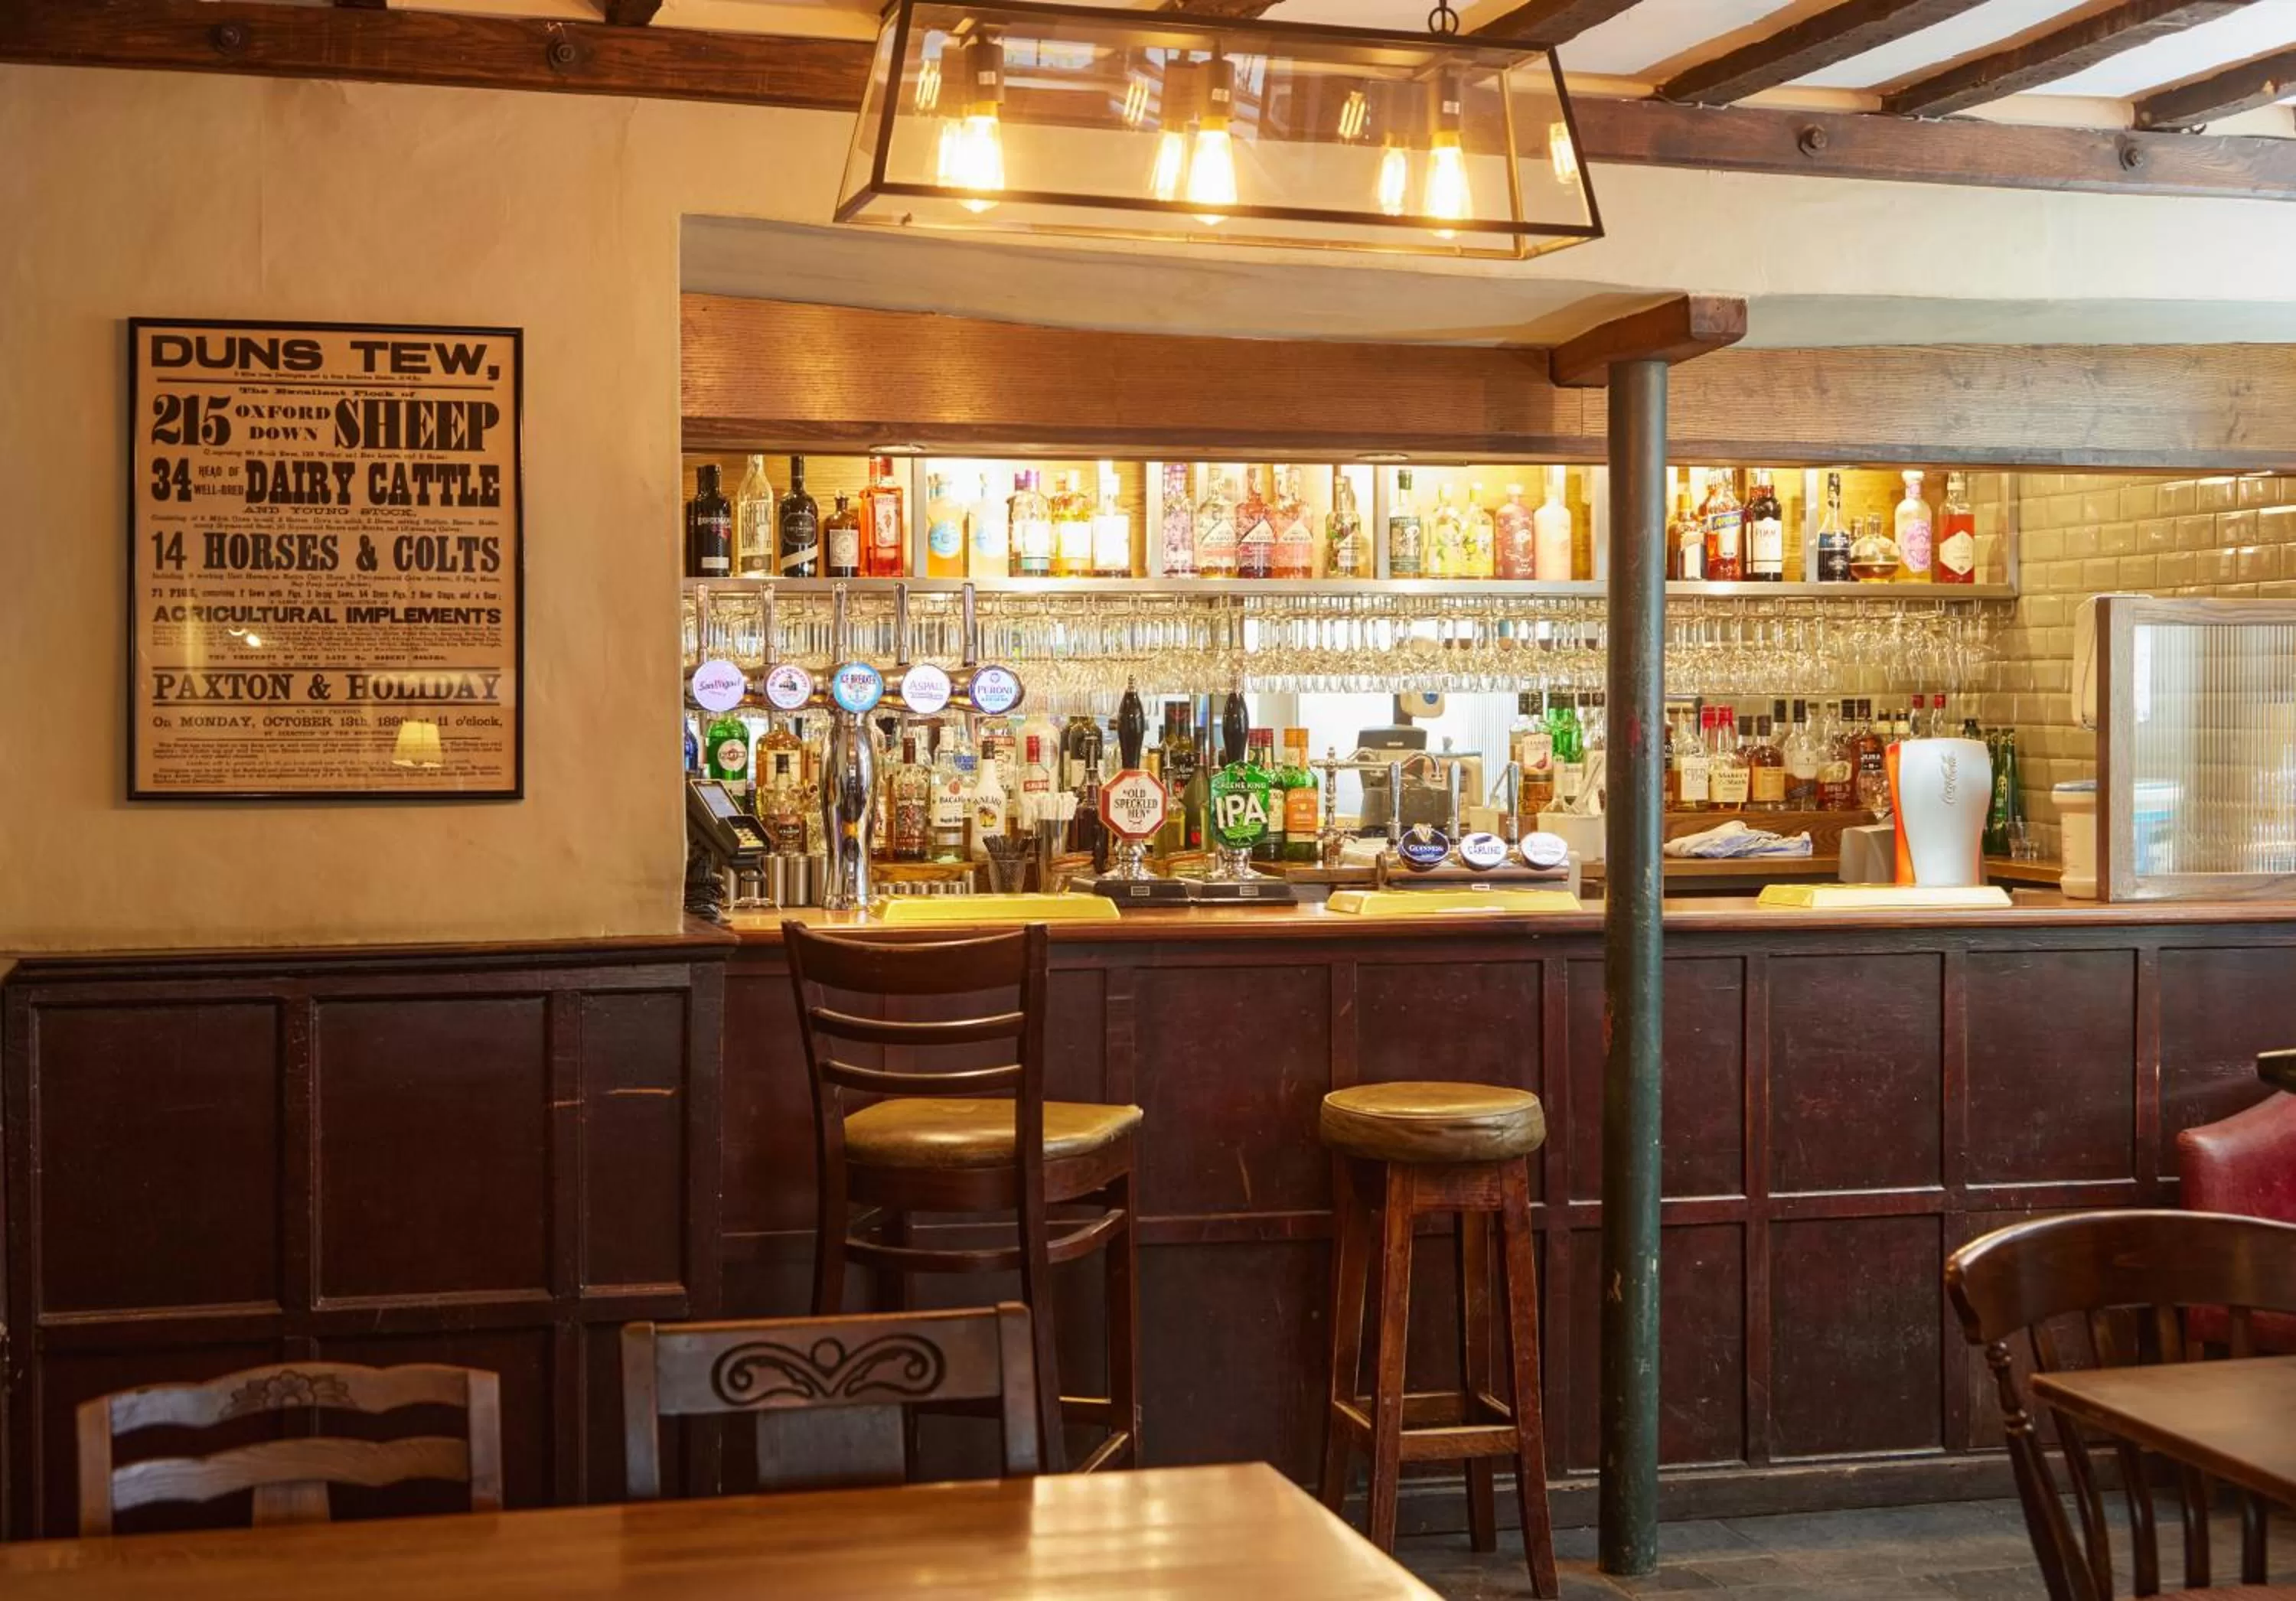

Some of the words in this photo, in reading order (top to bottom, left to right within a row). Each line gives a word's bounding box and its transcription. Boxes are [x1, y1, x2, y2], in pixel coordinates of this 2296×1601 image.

[151, 335, 324, 371] DUNS
[350, 341, 500, 380] TEW,
[152, 393, 231, 446] 215
[235, 405, 331, 421] OXFORD
[334, 397, 500, 452] SHEEP
[249, 426, 318, 442] DOWN
[151, 457, 191, 502] 34
[197, 465, 223, 478] HEAD
[228, 465, 241, 477] OF
[194, 484, 244, 496] WELL-BRED
[245, 460, 356, 505] DAIRY
[368, 461, 501, 507] CATTLE
[243, 506, 280, 515] AND
[291, 507, 350, 516] YOUNG
[151, 531, 188, 571] 14
[203, 532, 340, 572] HORSES
[356, 533, 378, 572] &
[393, 535, 501, 573] COLTS
[153, 605, 338, 624] AGRICULTURAL
[346, 607, 501, 624] IMPLEMENTS
[153, 673, 295, 700] PAXTON
[307, 673, 331, 700] &
[346, 673, 501, 700] HOLIDAY
[153, 716, 172, 728] On
[180, 716, 256, 729] MONDAY,
[263, 716, 333, 728] OCTOBER
[1114, 798, 1158, 809] SPECKLED
[1215, 792, 1268, 830] IPA
